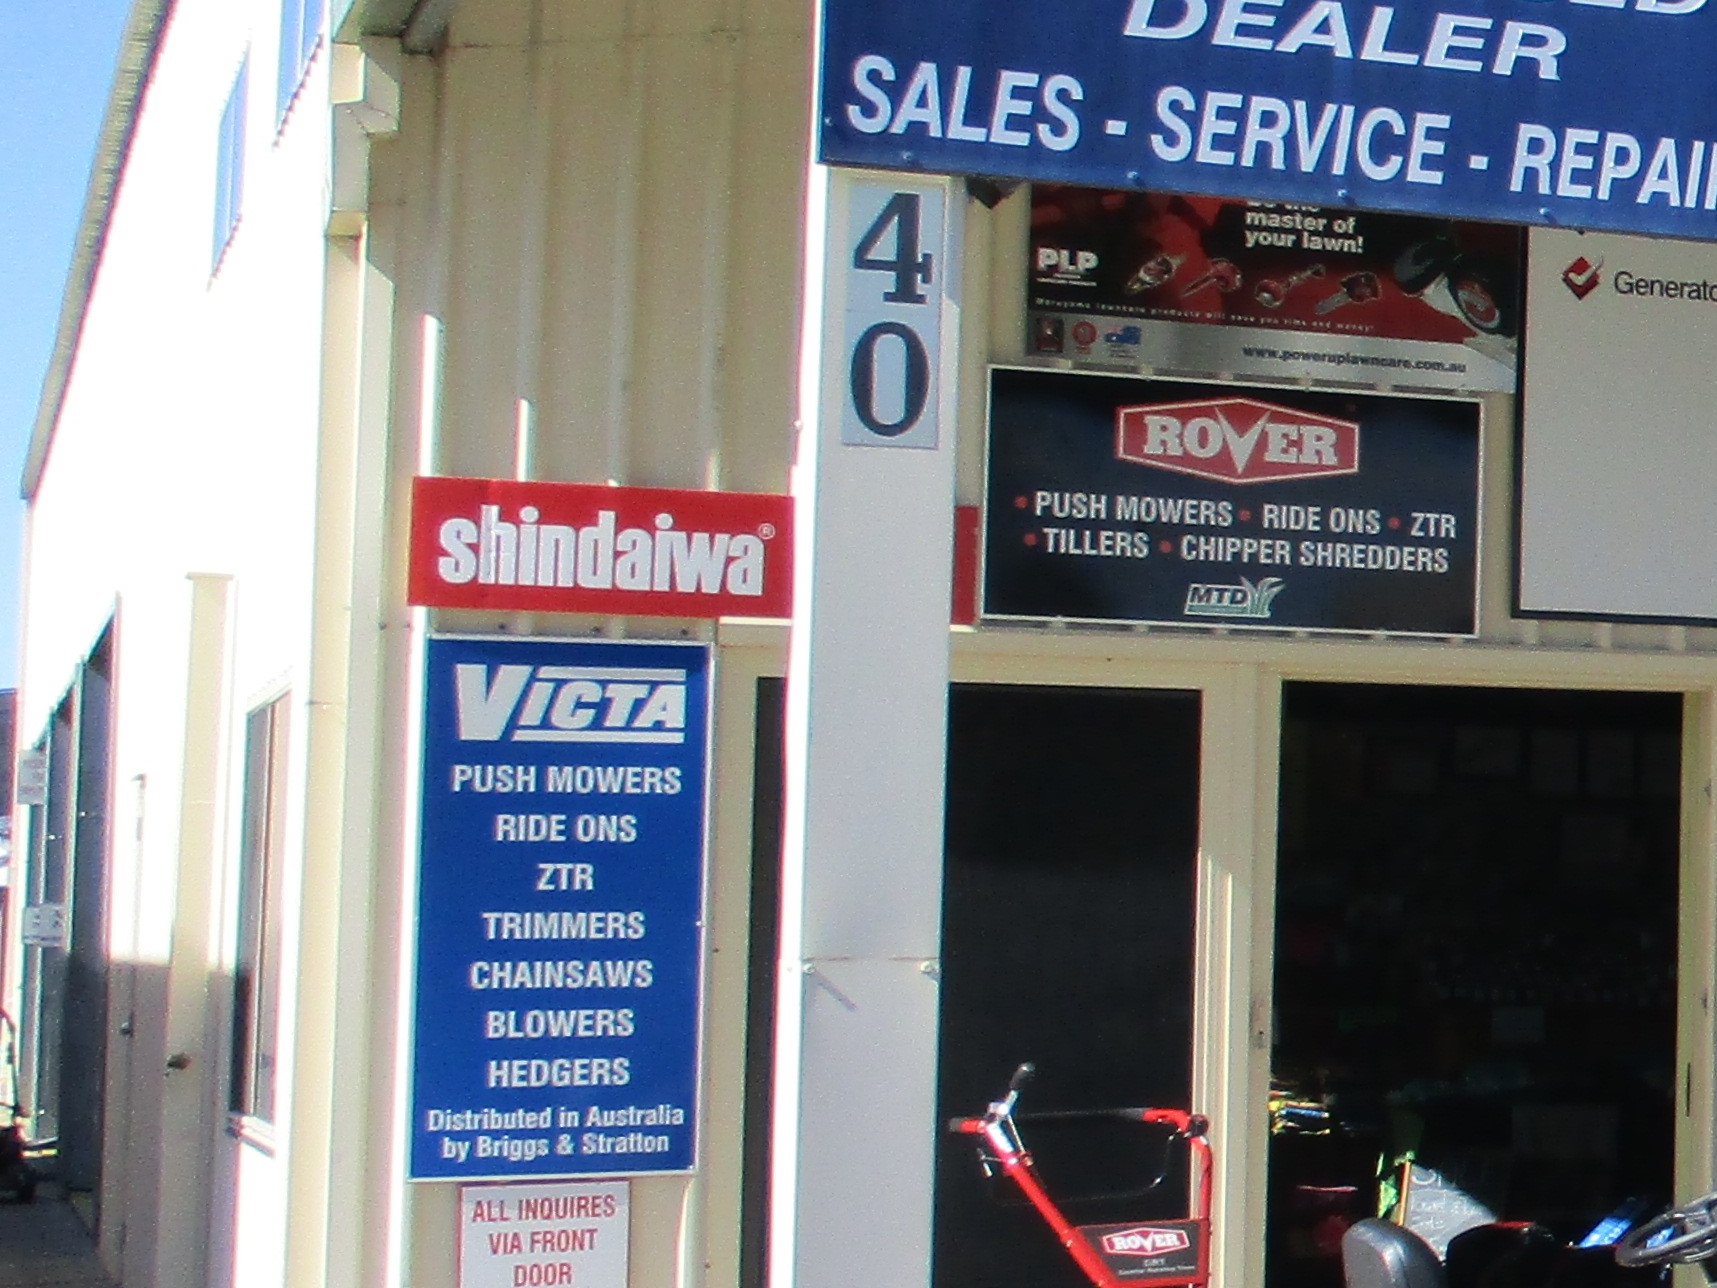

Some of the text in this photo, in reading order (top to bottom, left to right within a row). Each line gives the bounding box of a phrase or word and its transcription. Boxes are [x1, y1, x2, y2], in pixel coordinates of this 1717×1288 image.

[847, 54, 1084, 150] SALES
[1149, 85, 1450, 183] SERVICE
[1246, 212, 1356, 234] master of
[1245, 229, 1364, 254] your lawn!
[1037, 247, 1099, 272] PLP
[1143, 407, 1337, 475] ROVER
[1034, 490, 1457, 539] PUSH MOWERS RIDE ONS ZTR
[437, 504, 765, 597] shindaiwa
[1043, 527, 1449, 574] TILLERS CHIPPER SHREDDERS
[1189, 586, 1249, 605] MTD
[455, 663, 687, 742] VICTA
[452, 764, 682, 795] PUSH MOWERS
[494, 813, 638, 843] RIDE ONS
[536, 863, 595, 892] ZTR
[482, 912, 646, 940] TRIMMERS
[469, 960, 654, 990] CHAINSAWS
[485, 1009, 635, 1039] BLOWERS
[487, 1059, 631, 1088] HEDGERS
[427, 1104, 684, 1131] Distributed in Australia
[442, 1133, 670, 1163] by Briggs & Stratton
[471, 1195, 617, 1223] ALL INQUIRES
[488, 1228, 598, 1256] VIA FRONT
[1111, 1232, 1181, 1252] ROVER
[512, 1263, 572, 1288] DOOR
